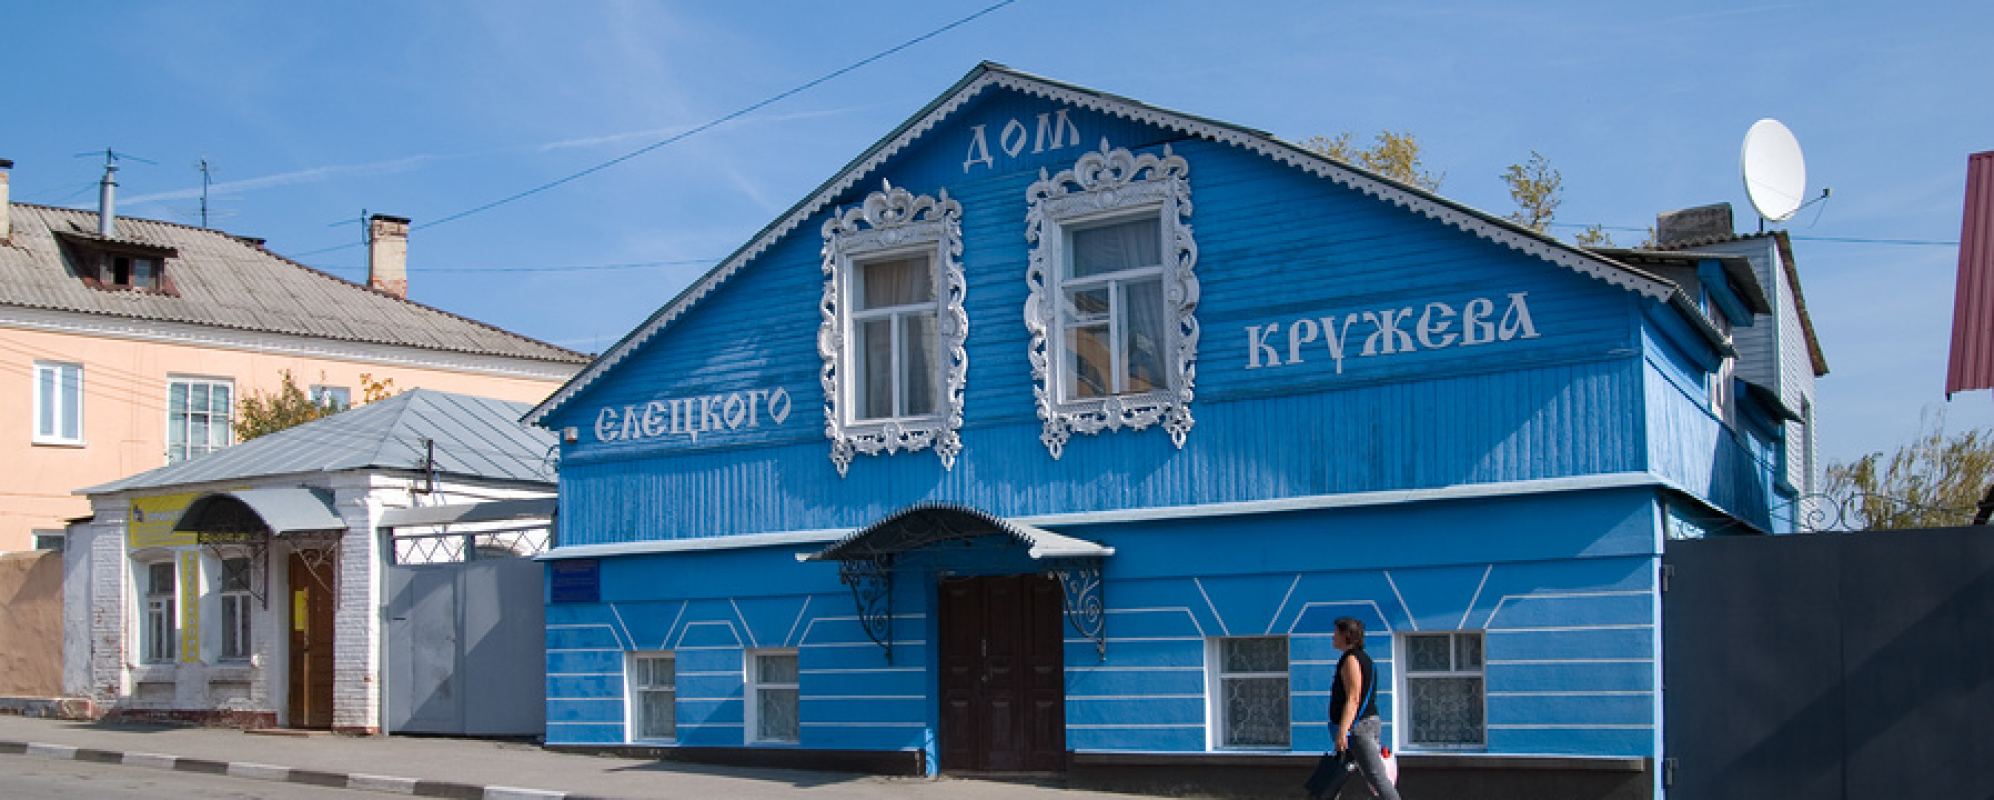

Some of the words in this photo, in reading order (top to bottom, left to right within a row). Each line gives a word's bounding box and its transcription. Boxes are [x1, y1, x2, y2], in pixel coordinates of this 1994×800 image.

[963, 108, 1081, 176] ДОМ
[594, 386, 792, 443] ЕЛЕЦКОГО
[1244, 291, 1542, 375] КРУЖЕВА
